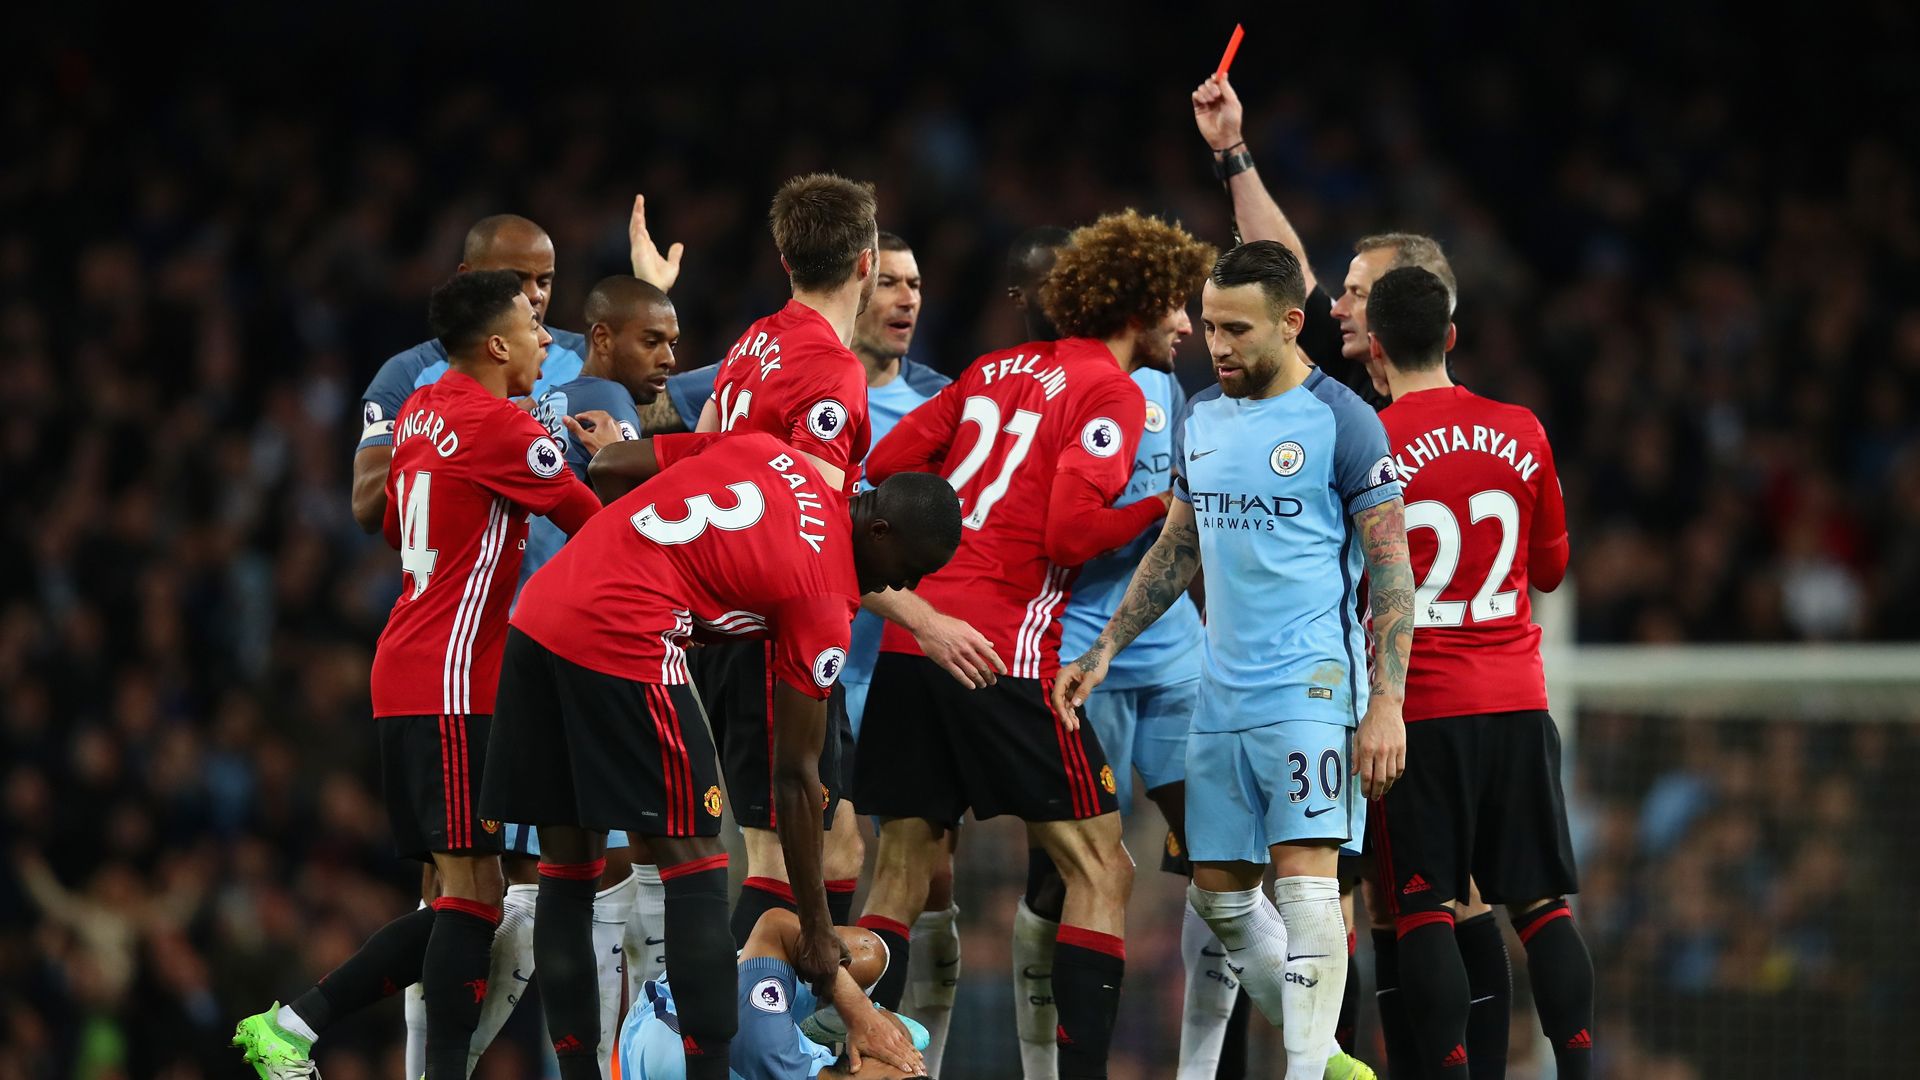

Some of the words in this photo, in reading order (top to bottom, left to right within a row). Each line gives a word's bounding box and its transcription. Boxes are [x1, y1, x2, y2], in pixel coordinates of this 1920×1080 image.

[1396, 424, 1539, 489] KHITARYAN
[629, 480, 765, 546] 3
[767, 453, 826, 554] BAILLY
[1191, 492, 1304, 518] ETIHAD
[1203, 517, 1275, 531] AIRWAYS
[1403, 489, 1520, 628] 22
[1287, 748, 1342, 803] 30
[1206, 970, 1237, 989] city
[1285, 972, 1319, 988] city
